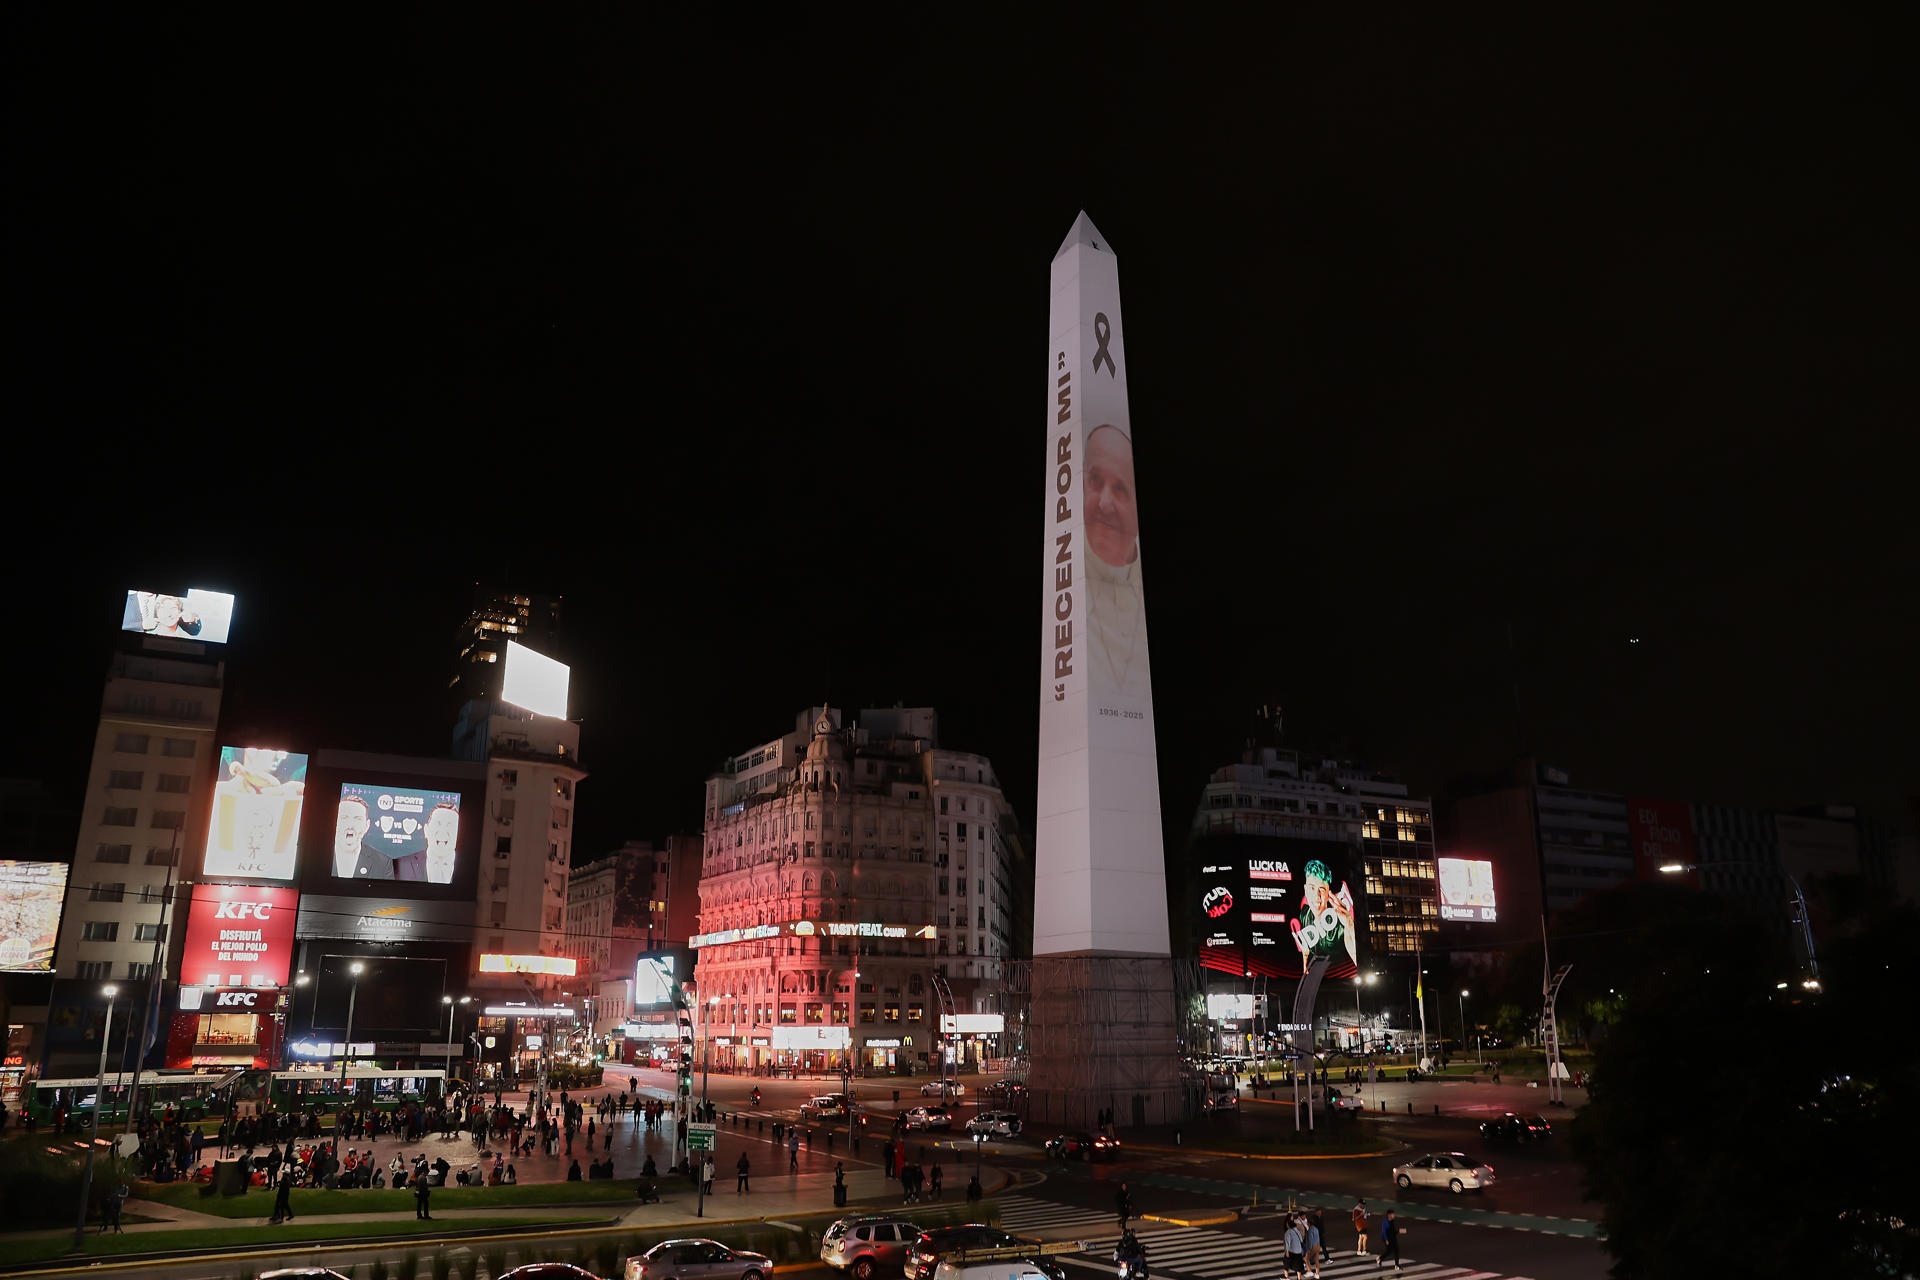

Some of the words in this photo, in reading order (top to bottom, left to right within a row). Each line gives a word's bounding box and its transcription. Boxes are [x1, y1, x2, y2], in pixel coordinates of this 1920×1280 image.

[1056, 431, 1072, 524] POR
[394, 795, 424, 805] SPORTS
[1638, 808, 1659, 825] EDI
[237, 862, 266, 872] KFC
[1249, 860, 1275, 871] LUCK
[1275, 862, 1289, 872] RA
[214, 902, 273, 920] KFC
[356, 916, 412, 928] Atacama
[219, 929, 262, 942] DISFRUTÁ
[828, 923, 859, 936] TASTY
[859, 922, 883, 937] FEAT.
[211, 941, 220, 951] EL
[221, 941, 245, 951] MEJOR
[245, 942, 268, 952] POLLO
[217, 951, 232, 961] DEL
[232, 952, 259, 962] MUNDO
[217, 992, 258, 1006] KFC
[195, 1056, 222, 1065] KFC
